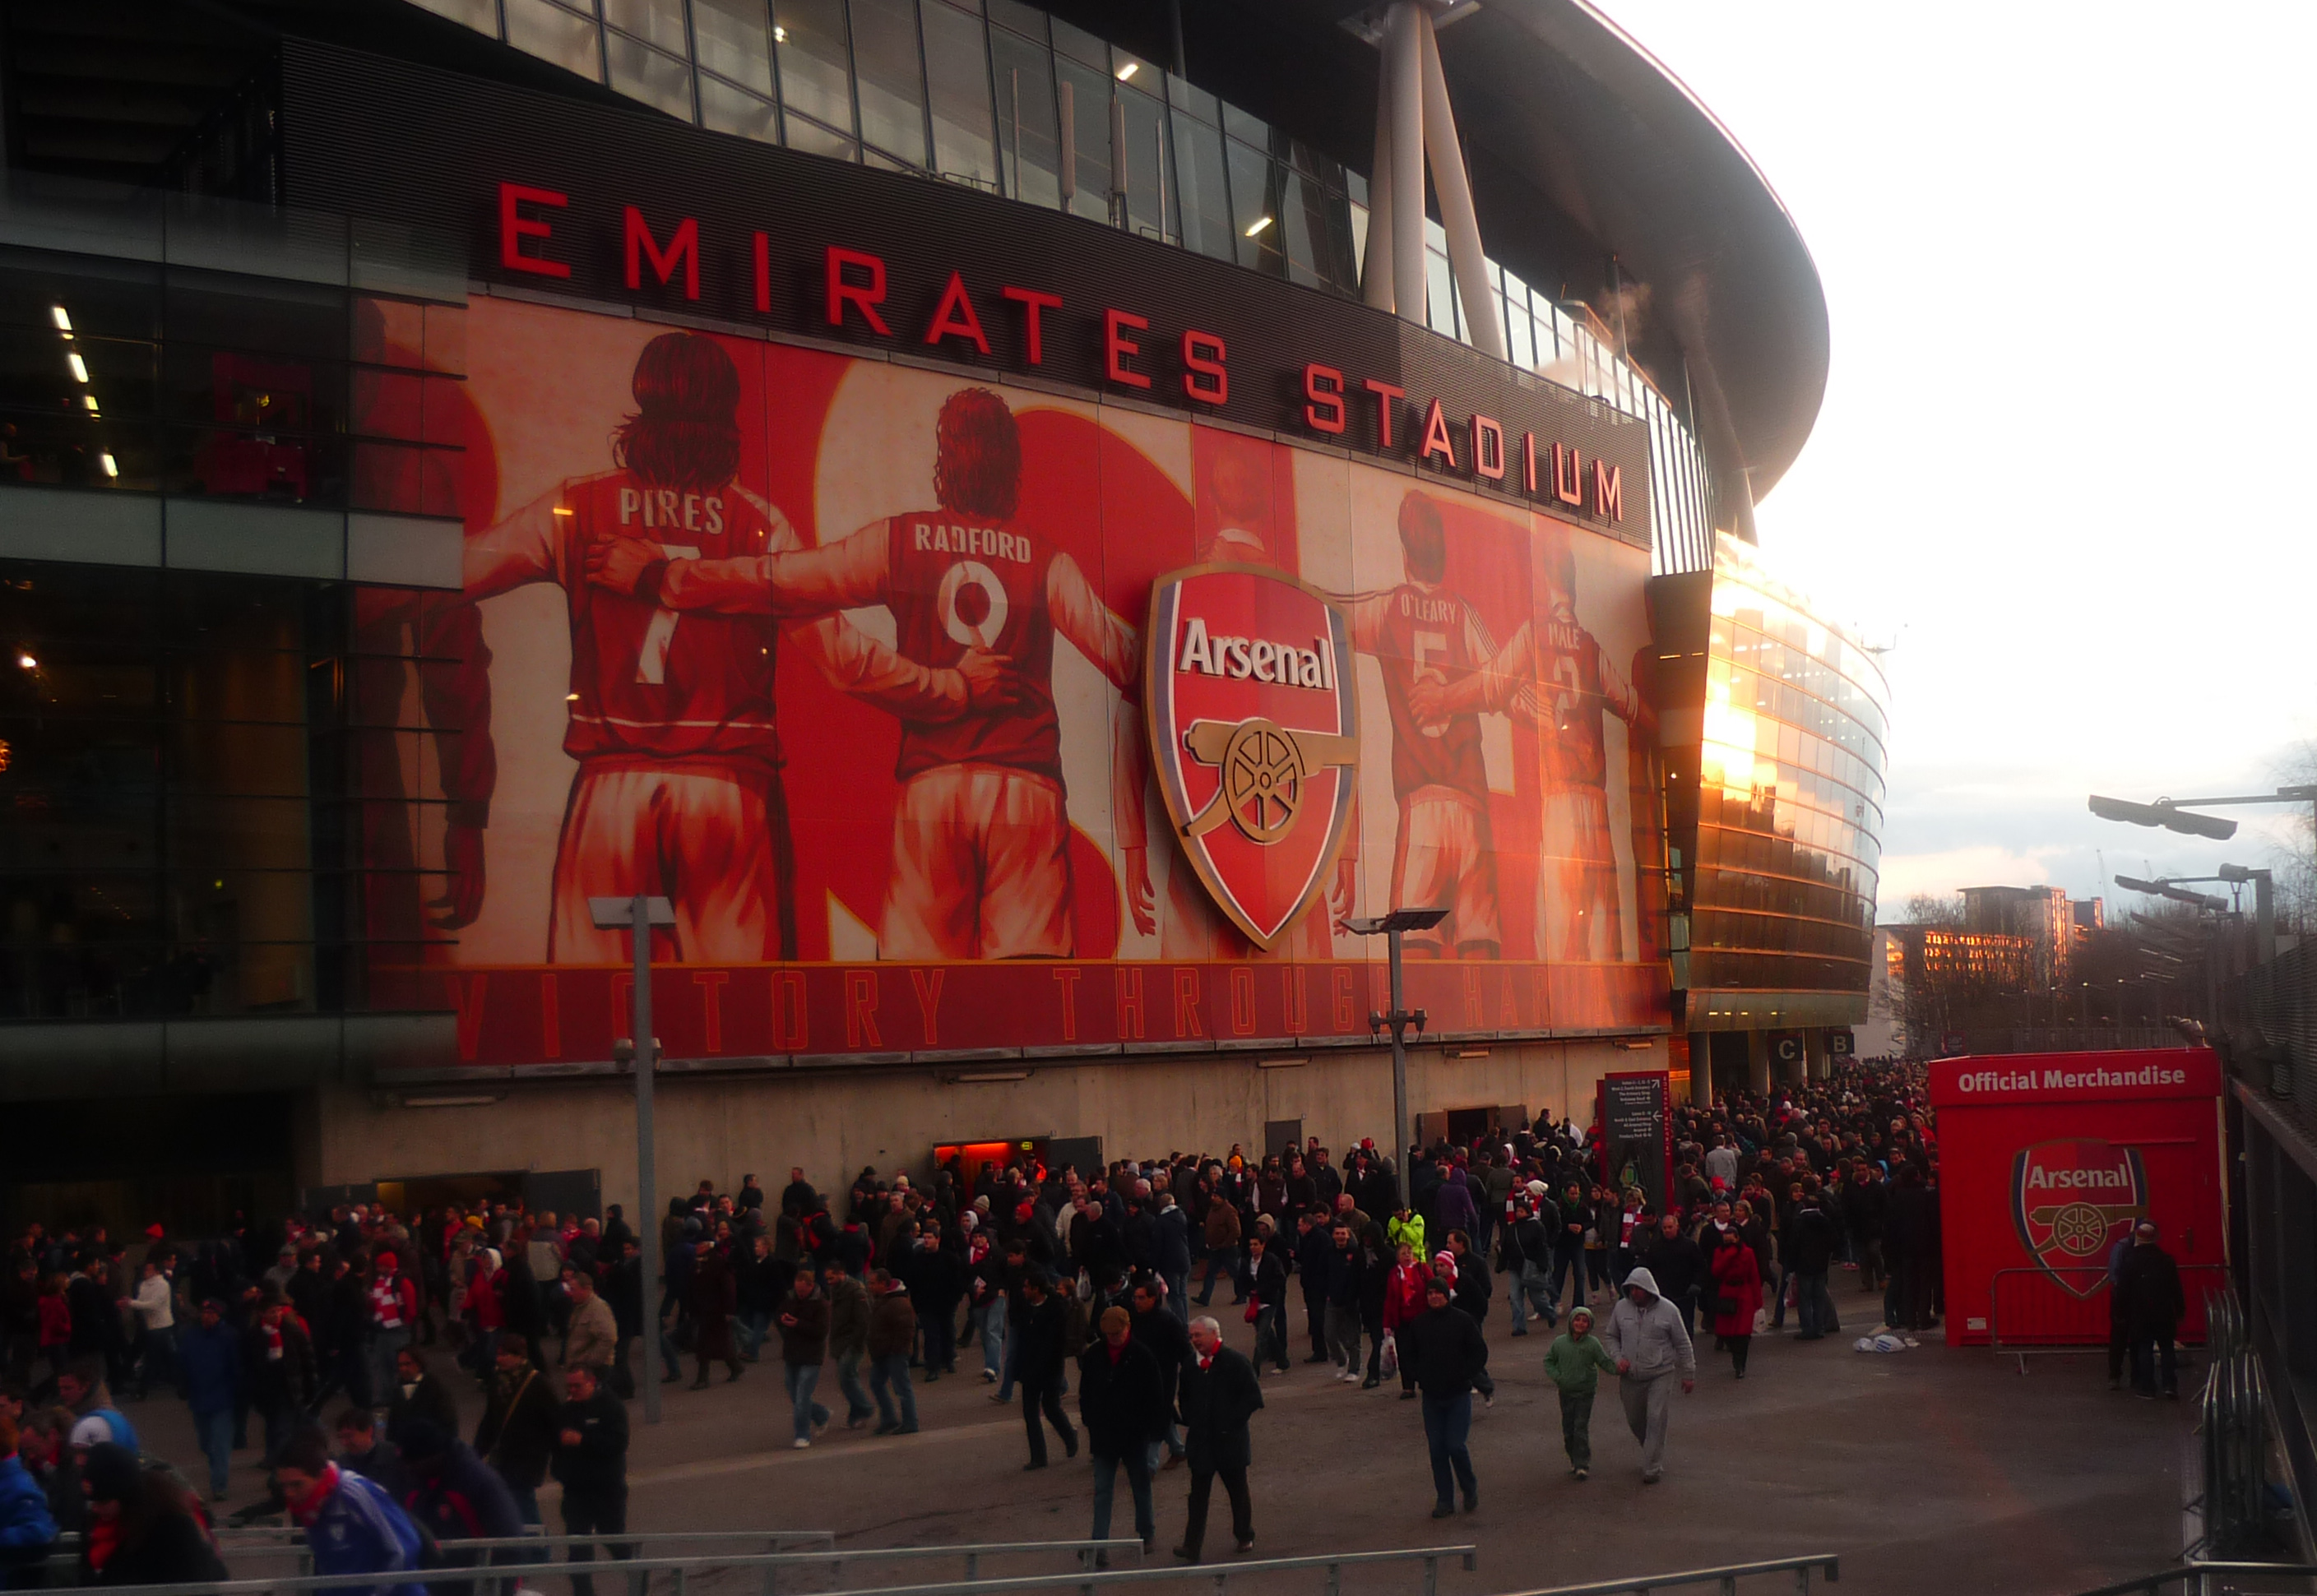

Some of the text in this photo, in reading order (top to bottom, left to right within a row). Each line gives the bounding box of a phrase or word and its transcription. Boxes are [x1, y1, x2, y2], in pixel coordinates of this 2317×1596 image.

[498, 181, 1622, 522] EMIRATES STADIUM
[620, 487, 724, 534] PIRES
[915, 523, 1032, 564] RADFORD
[1401, 593, 1457, 625] O'LEARY
[1177, 617, 1334, 691] Arsenal
[447, 968, 945, 1061] VICTORY
[1778, 1039, 1796, 1061] C
[1833, 1035, 1847, 1053] B
[1958, 1065, 2186, 1093] Official Merchandise
[2027, 1163, 2129, 1189] Arsenal
